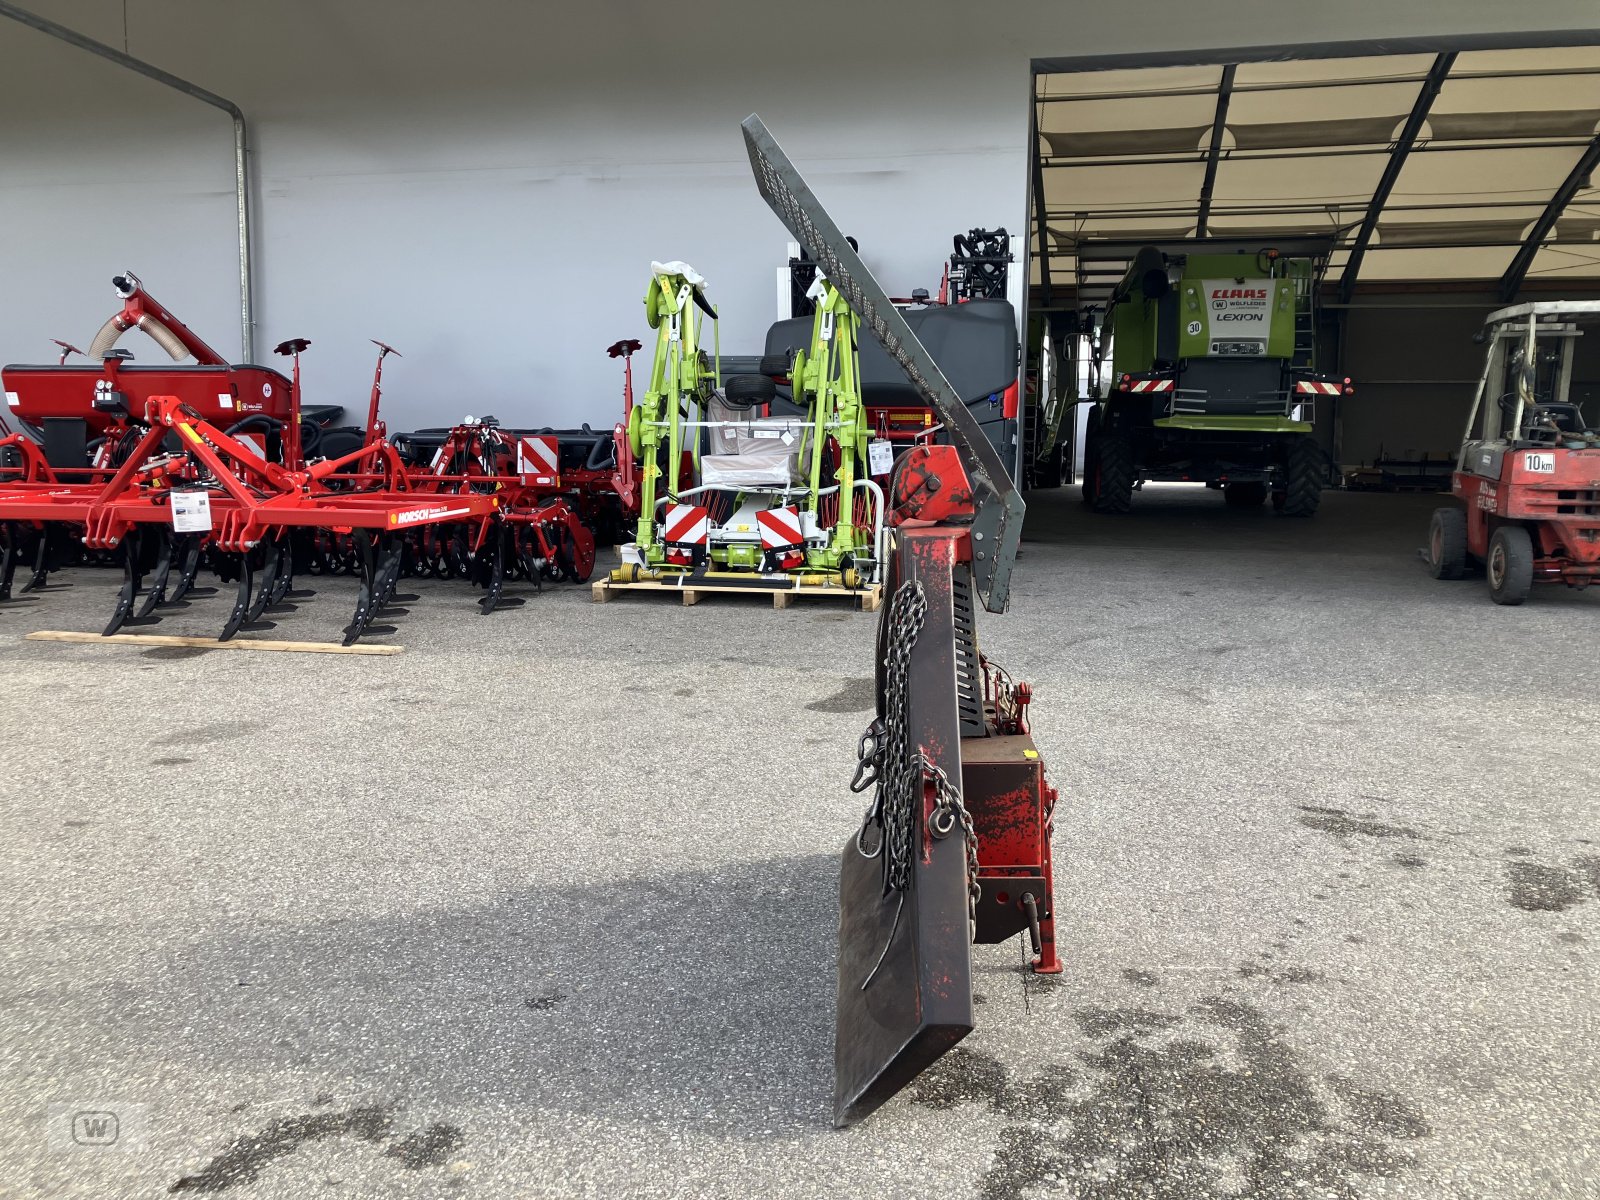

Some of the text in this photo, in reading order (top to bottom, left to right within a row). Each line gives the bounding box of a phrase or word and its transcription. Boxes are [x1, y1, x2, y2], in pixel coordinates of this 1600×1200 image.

[1212, 289, 1267, 298] CLAAS
[1216, 313, 1264, 321] LEXION
[1189, 322, 1200, 333] 30
[1527, 455, 1553, 471] 10 km
[398, 508, 429, 524] HORSCH
